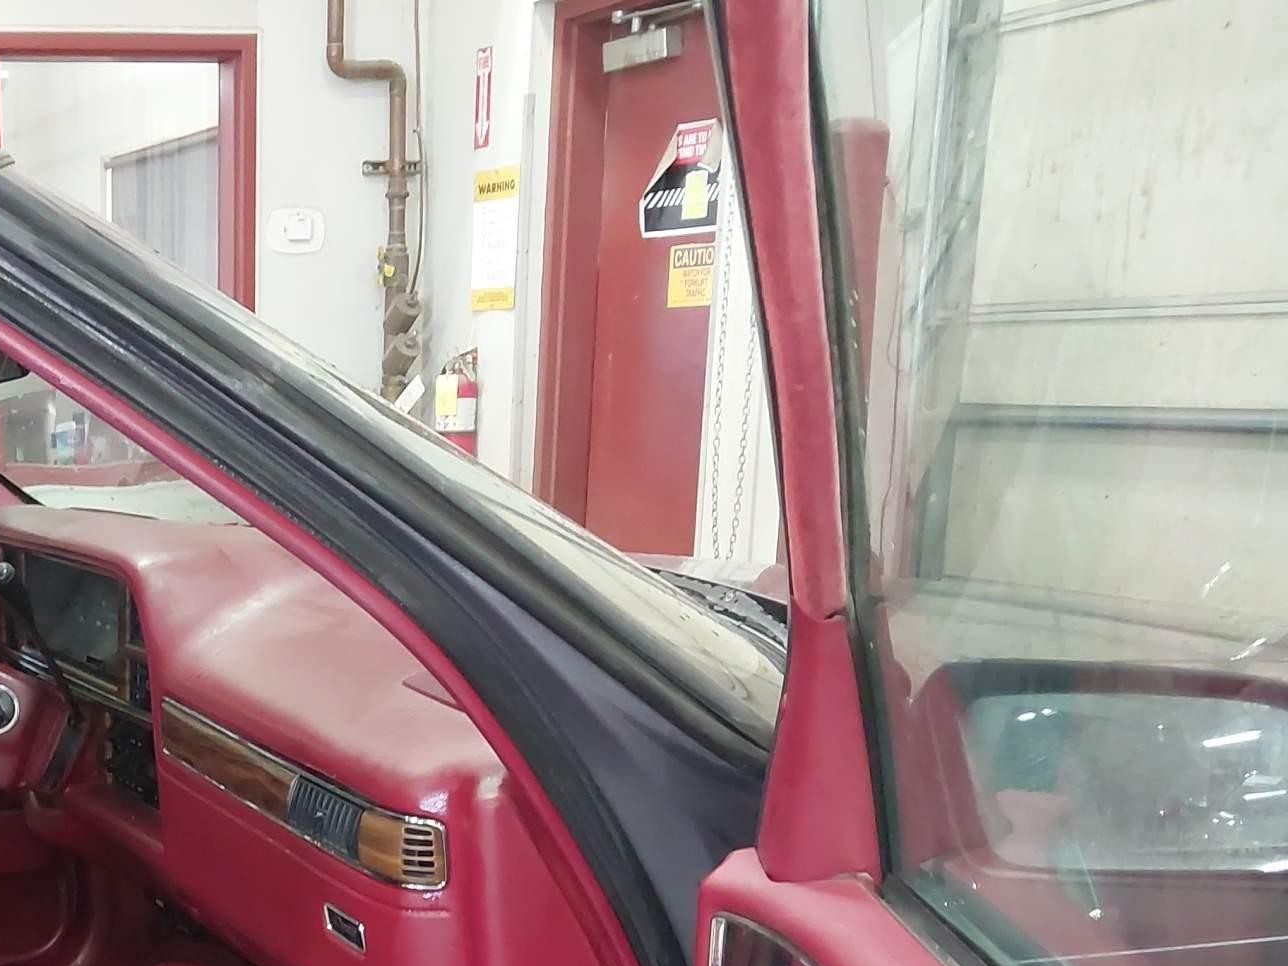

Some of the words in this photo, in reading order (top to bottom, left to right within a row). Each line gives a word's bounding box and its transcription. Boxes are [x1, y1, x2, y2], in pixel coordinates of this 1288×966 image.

[683, 131, 697, 146] ARE
[478, 178, 516, 195] WARNING
[674, 247, 714, 267] CAUTIO
